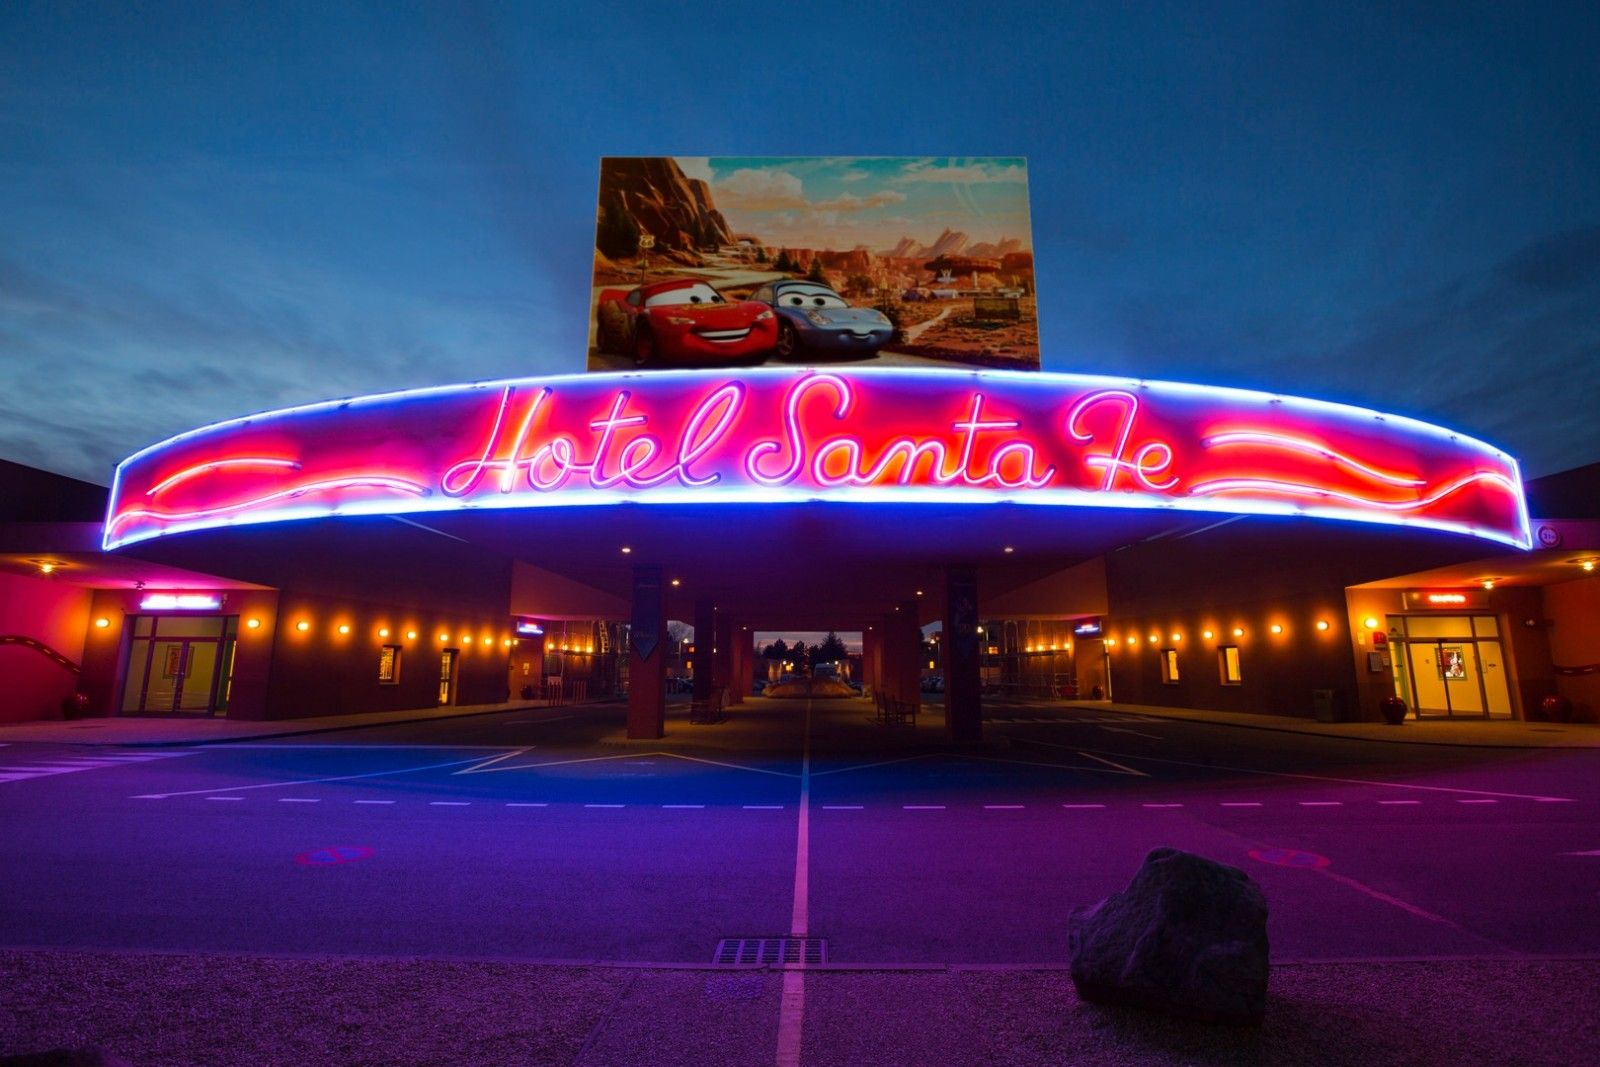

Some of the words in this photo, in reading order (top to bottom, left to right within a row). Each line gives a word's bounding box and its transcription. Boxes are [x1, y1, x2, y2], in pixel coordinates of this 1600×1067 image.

[442, 381, 745, 496] Hotel
[746, 373, 1056, 488] Santa
[1066, 389, 1180, 492] Fe
